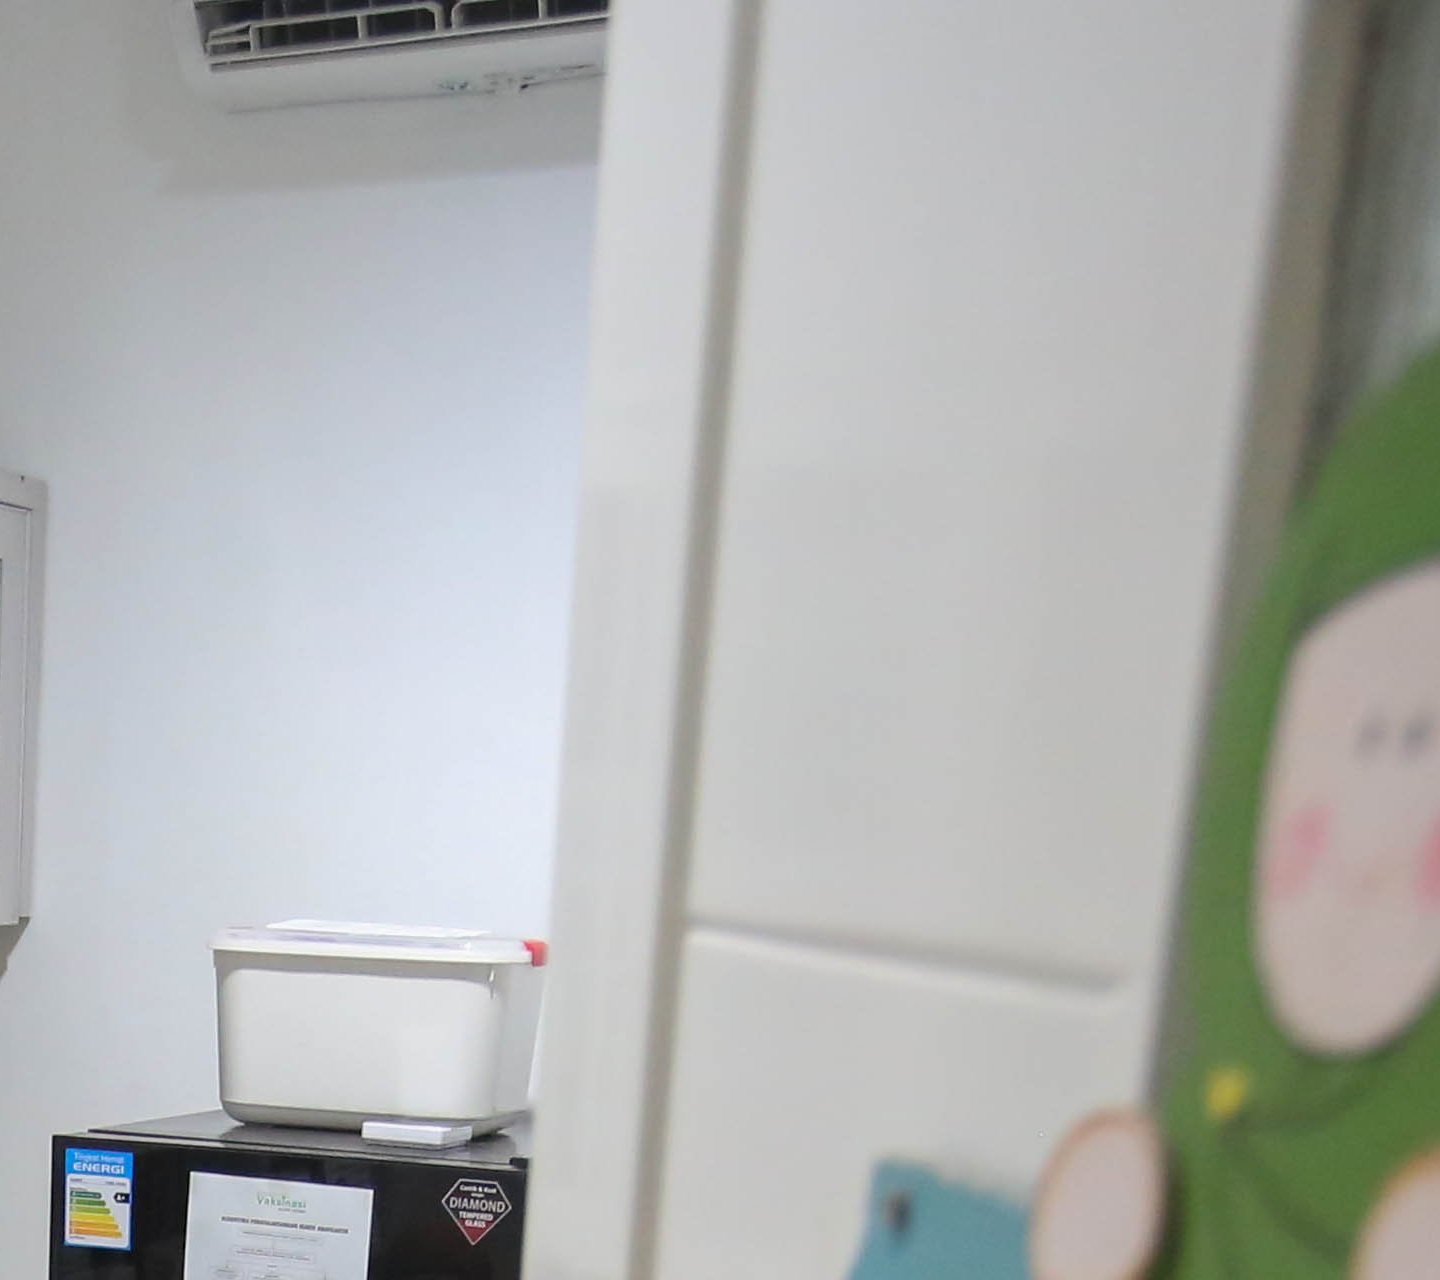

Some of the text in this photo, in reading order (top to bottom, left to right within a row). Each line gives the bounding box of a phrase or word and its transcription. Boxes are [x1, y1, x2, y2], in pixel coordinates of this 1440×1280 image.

[73, 1162, 125, 1174] ENERGI
[449, 1197, 506, 1213] DIAMOND
[465, 1219, 486, 1228] GLASS
